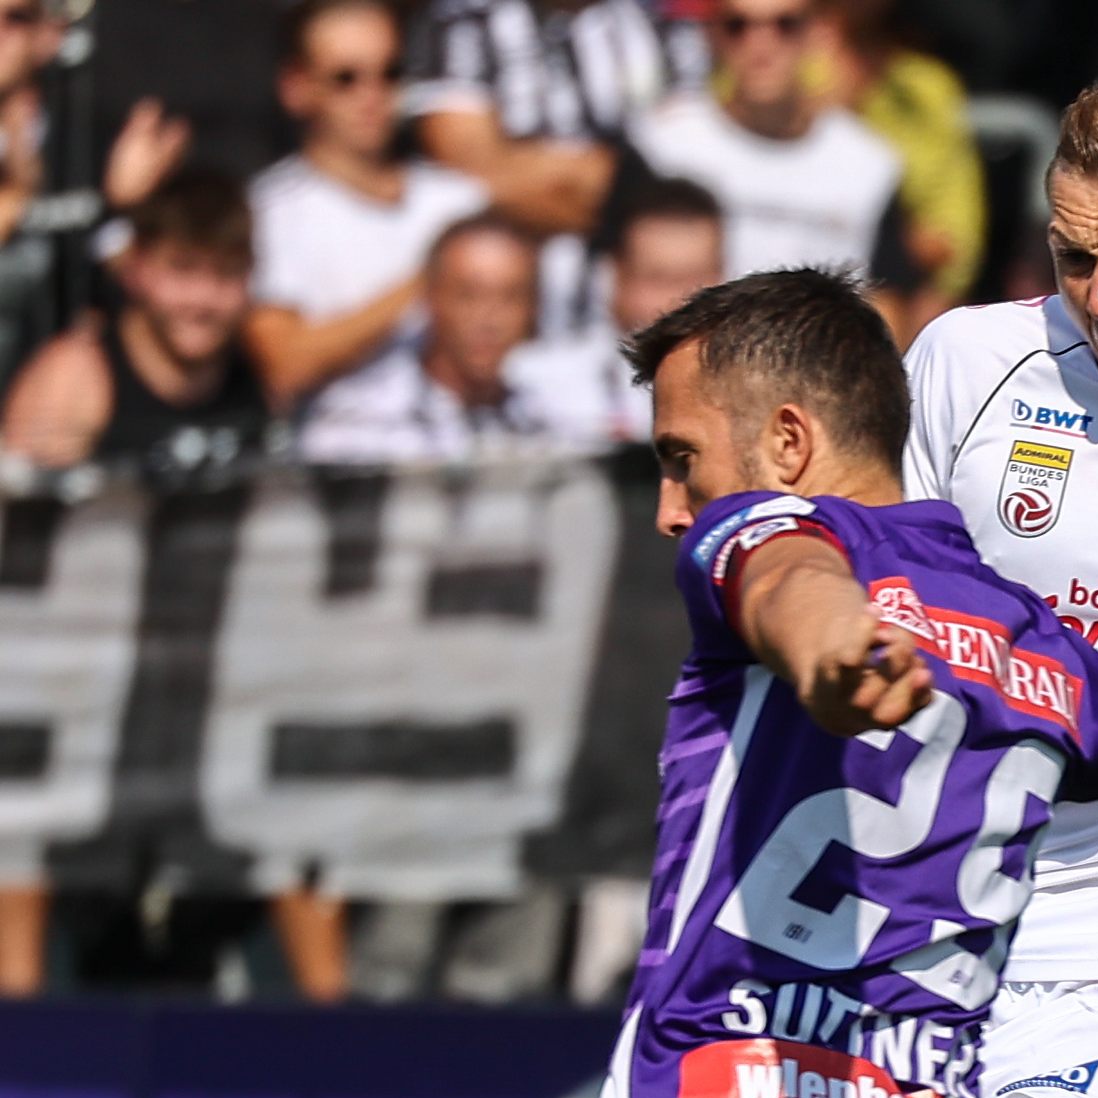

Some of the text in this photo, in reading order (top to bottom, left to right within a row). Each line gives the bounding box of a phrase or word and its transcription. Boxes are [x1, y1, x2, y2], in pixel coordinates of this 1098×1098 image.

[1035, 407, 1093, 432] BWT
[1014, 447, 1068, 465] ADMIRAL
[1009, 463, 1064, 481] BUNDES
[1018, 475, 1049, 488] LIGA
